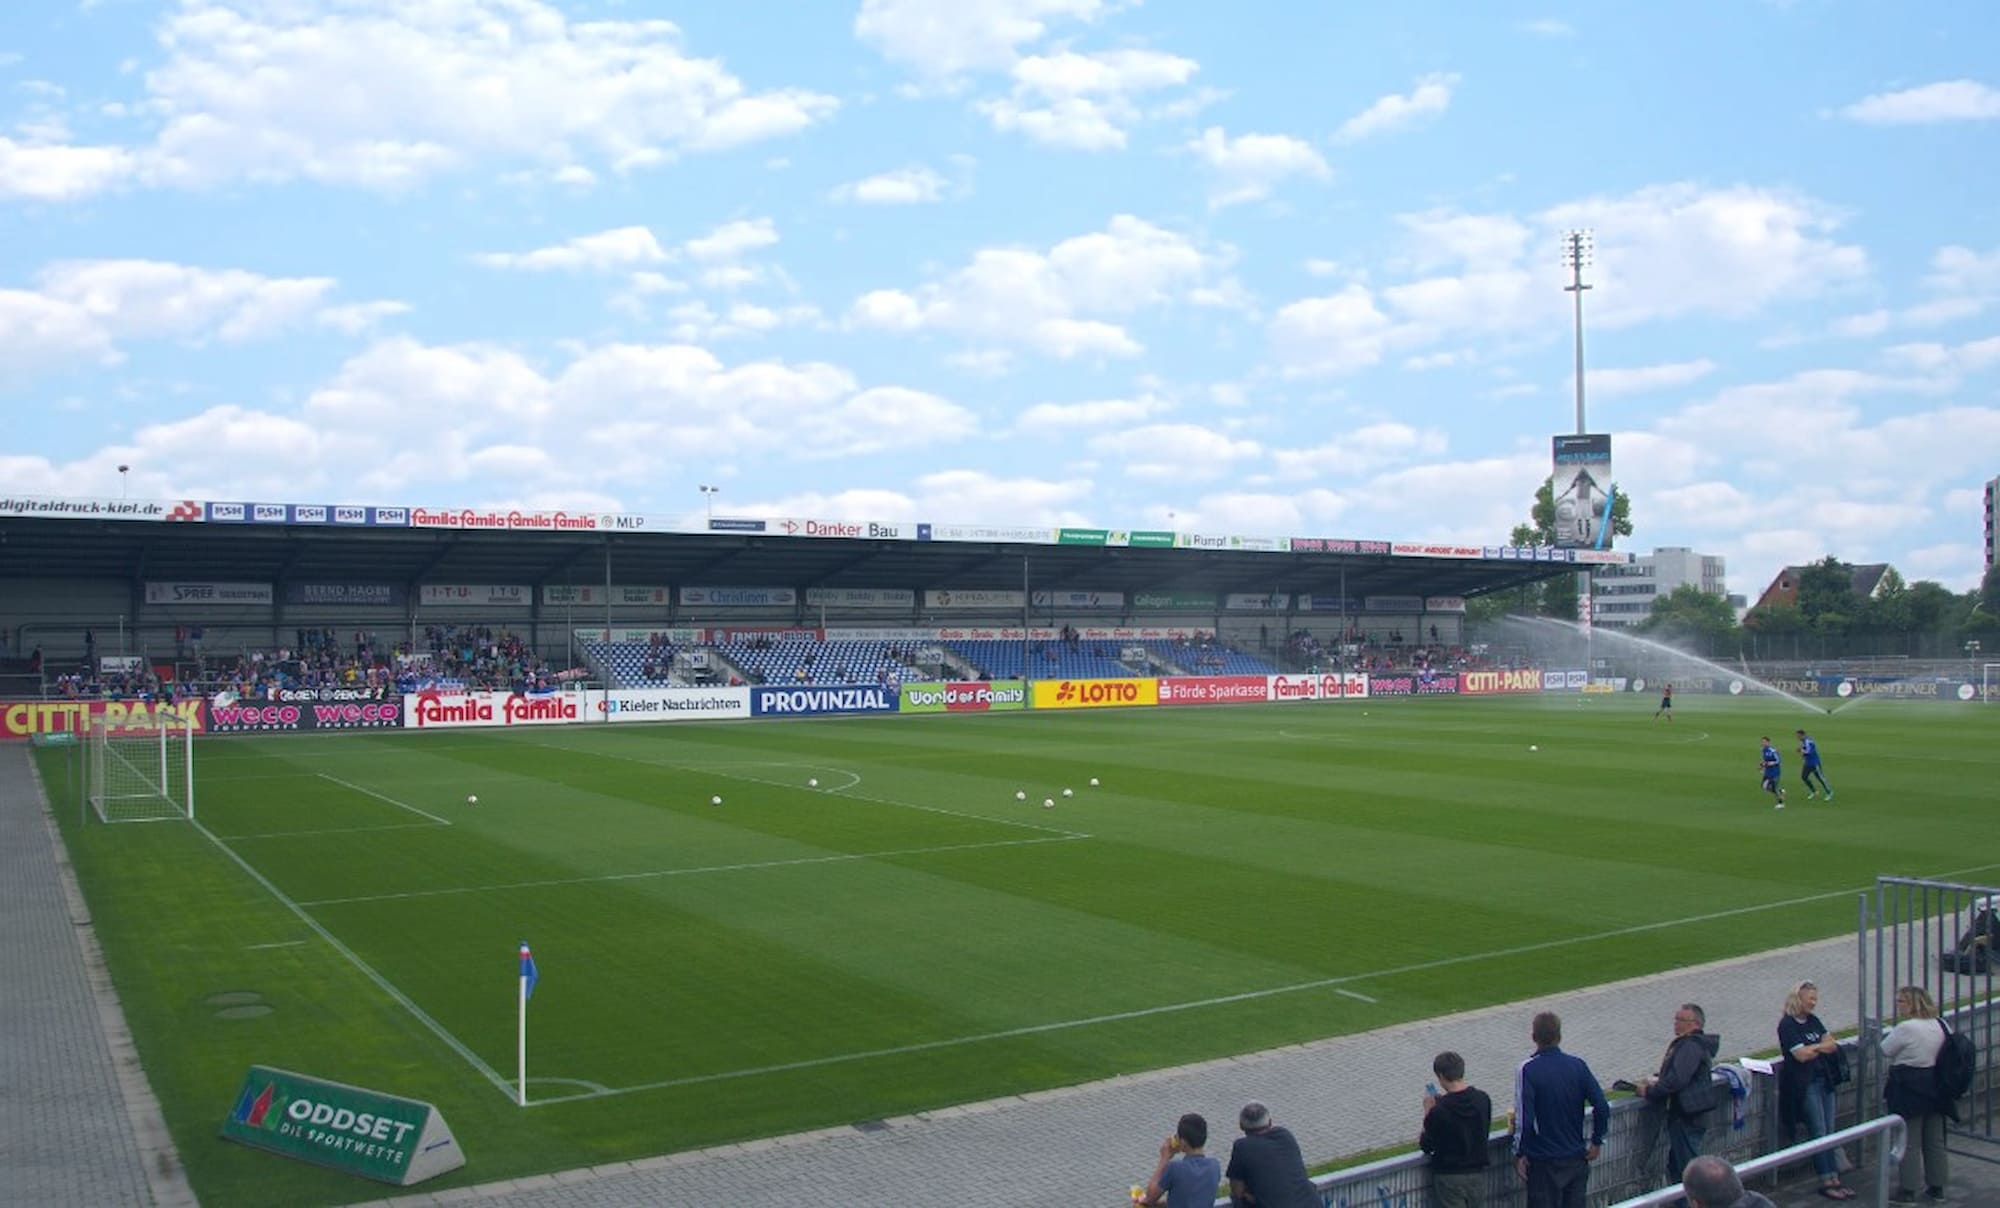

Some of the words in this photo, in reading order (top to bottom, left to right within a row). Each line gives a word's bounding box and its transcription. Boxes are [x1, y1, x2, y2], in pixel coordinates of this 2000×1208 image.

[616, 517, 644, 528] MLP
[806, 521, 863, 537] Danker
[869, 523, 898, 538] Bau
[1080, 683, 1138, 702] LOTTO
[1172, 682, 1206, 699] Förde
[1209, 682, 1266, 700] Sparkasse
[1273, 675, 1316, 698] famila
[620, 700, 659, 714] Kieler
[662, 698, 741, 712] Nachrichten
[761, 690, 890, 712] PROVINZIAL
[908, 688, 955, 706] World
[975, 687, 1024, 706] Family
[211, 706, 301, 725] weco
[313, 703, 399, 722] weco
[414, 690, 492, 727] famila
[502, 690, 576, 725] famila
[288, 1099, 415, 1145] ODDSET
[280, 1121, 303, 1138] DIE
[307, 1130, 404, 1166] SPORTWETTE
